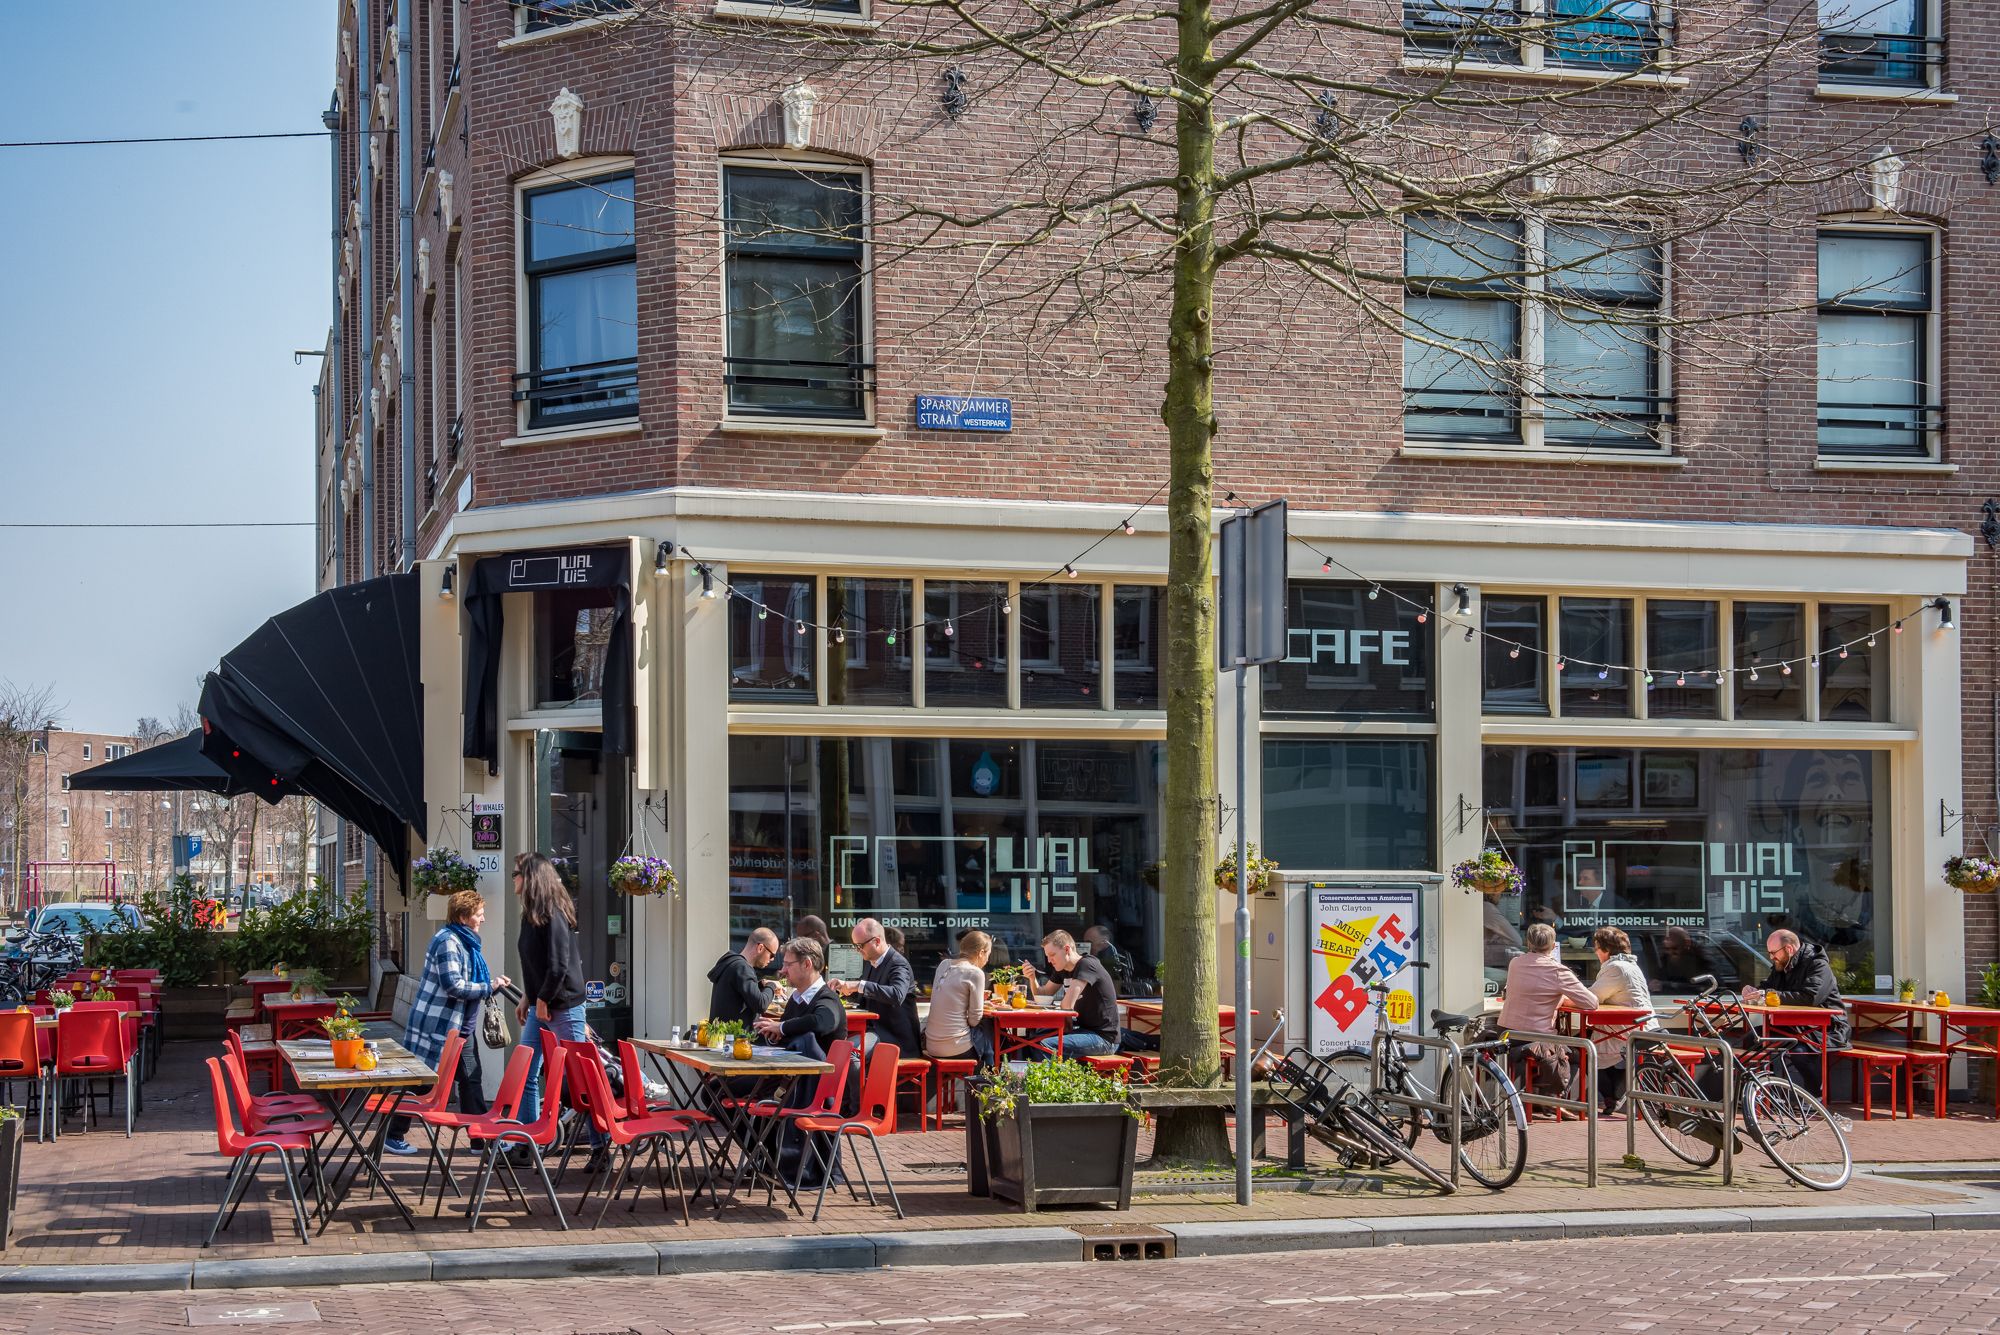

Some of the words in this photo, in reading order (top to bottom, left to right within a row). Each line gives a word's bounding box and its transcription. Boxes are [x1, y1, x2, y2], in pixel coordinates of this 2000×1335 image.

[920, 398, 1009, 414] SPAARNDAMMER
[920, 413, 959, 425] STRAAT
[963, 418, 1007, 427] WESTERPARK
[561, 554, 592, 569] WAL
[1279, 629, 1410, 665] CAFE
[482, 803, 504, 811] WHALES
[192, 842, 198, 851] P
[996, 837, 1099, 873] WAL
[1709, 842, 1802, 876] WAL
[479, 857, 498, 870] 516
[1320, 904, 1340, 912] John
[1341, 904, 1372, 912] Clayton
[1336, 919, 1373, 947] MUSIC
[1319, 939, 1360, 957] HEART
[1376, 993, 1413, 1002] BMHUIS
[1389, 1002, 1406, 1019] 11
[1319, 1039, 1350, 1047] Concert
